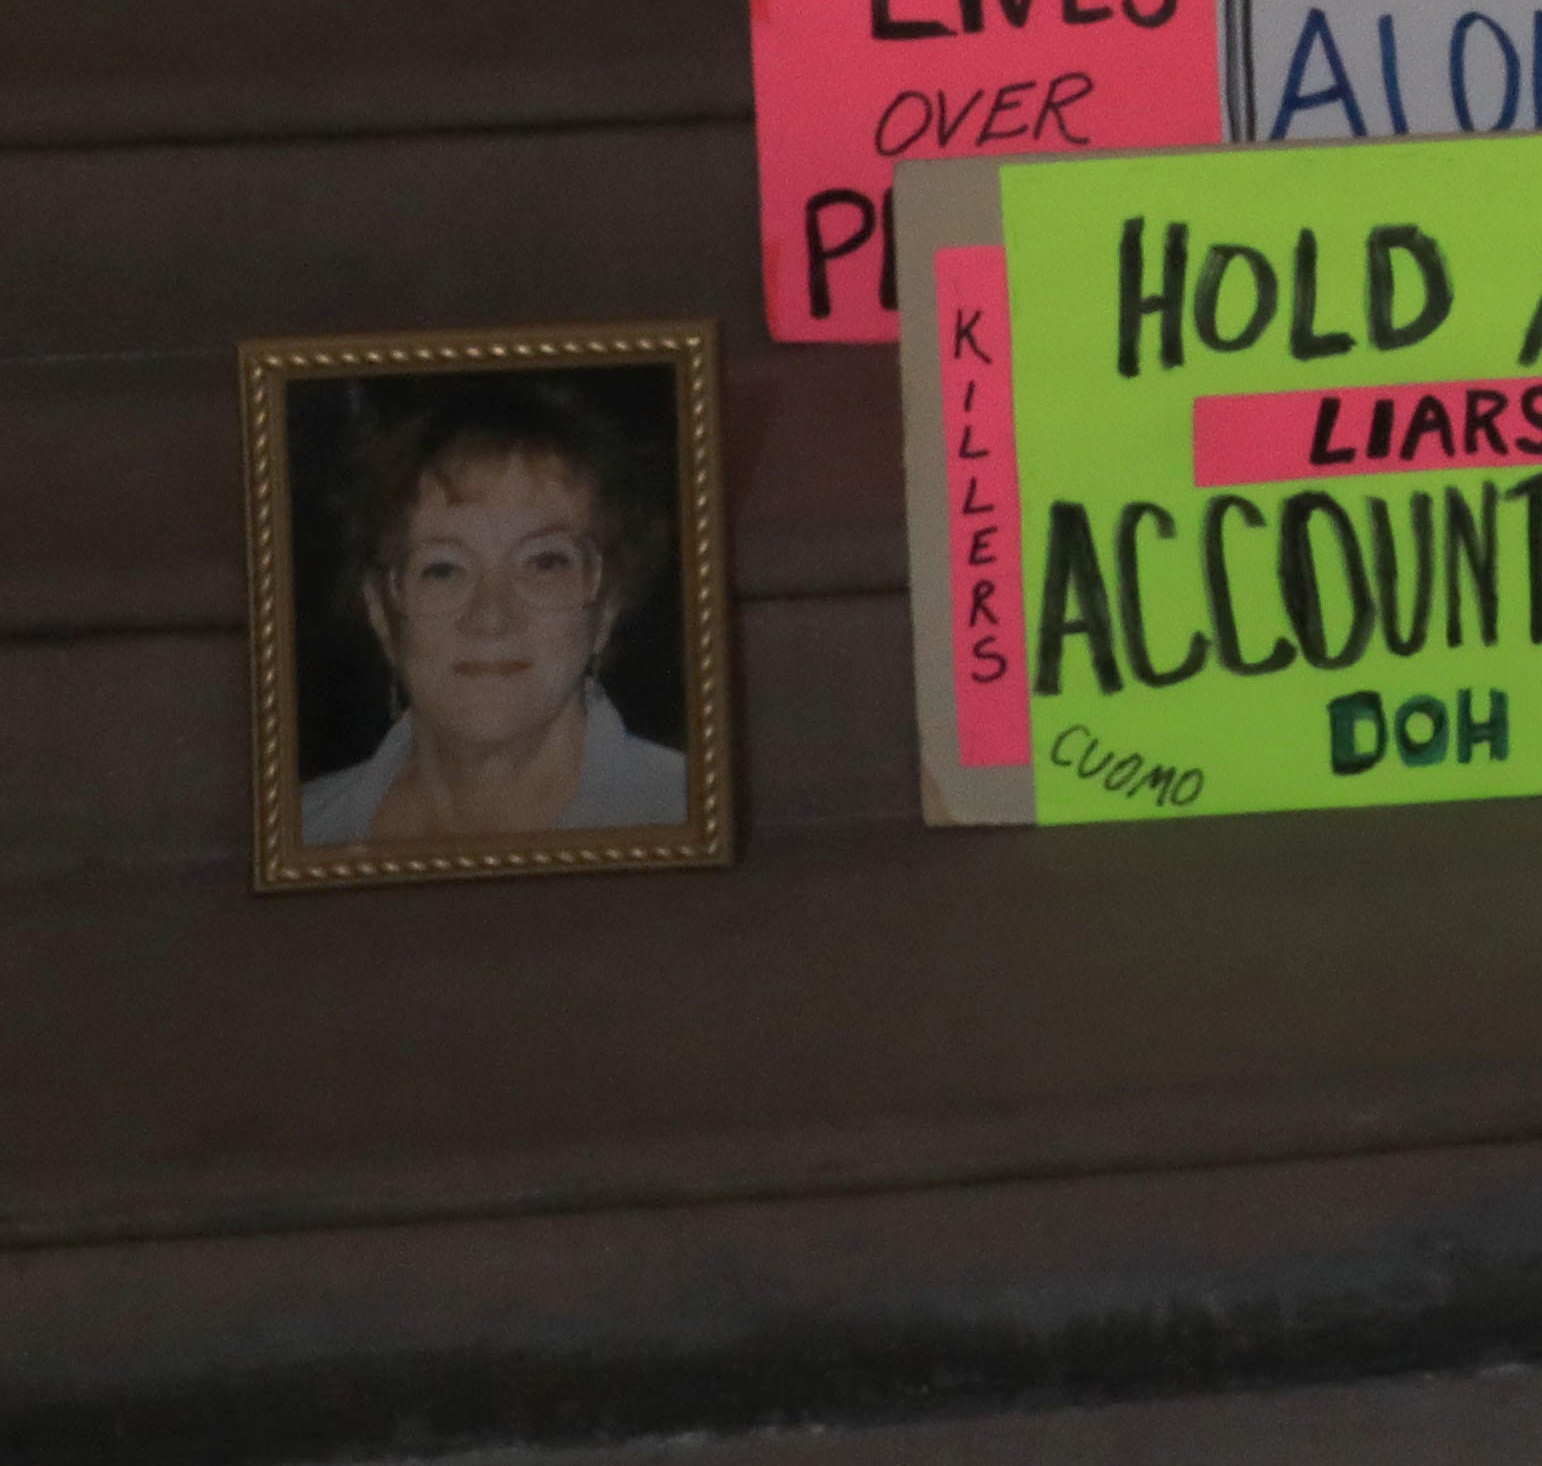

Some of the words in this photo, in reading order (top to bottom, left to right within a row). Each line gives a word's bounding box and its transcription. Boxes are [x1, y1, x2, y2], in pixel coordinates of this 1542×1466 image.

[873, 71, 1094, 158] OVER
[1116, 214, 1455, 380] HOLD
[953, 307, 1008, 685] KILLERS
[1048, 724, 1205, 807] CUOMO
[1327, 686, 1511, 775] DOH
